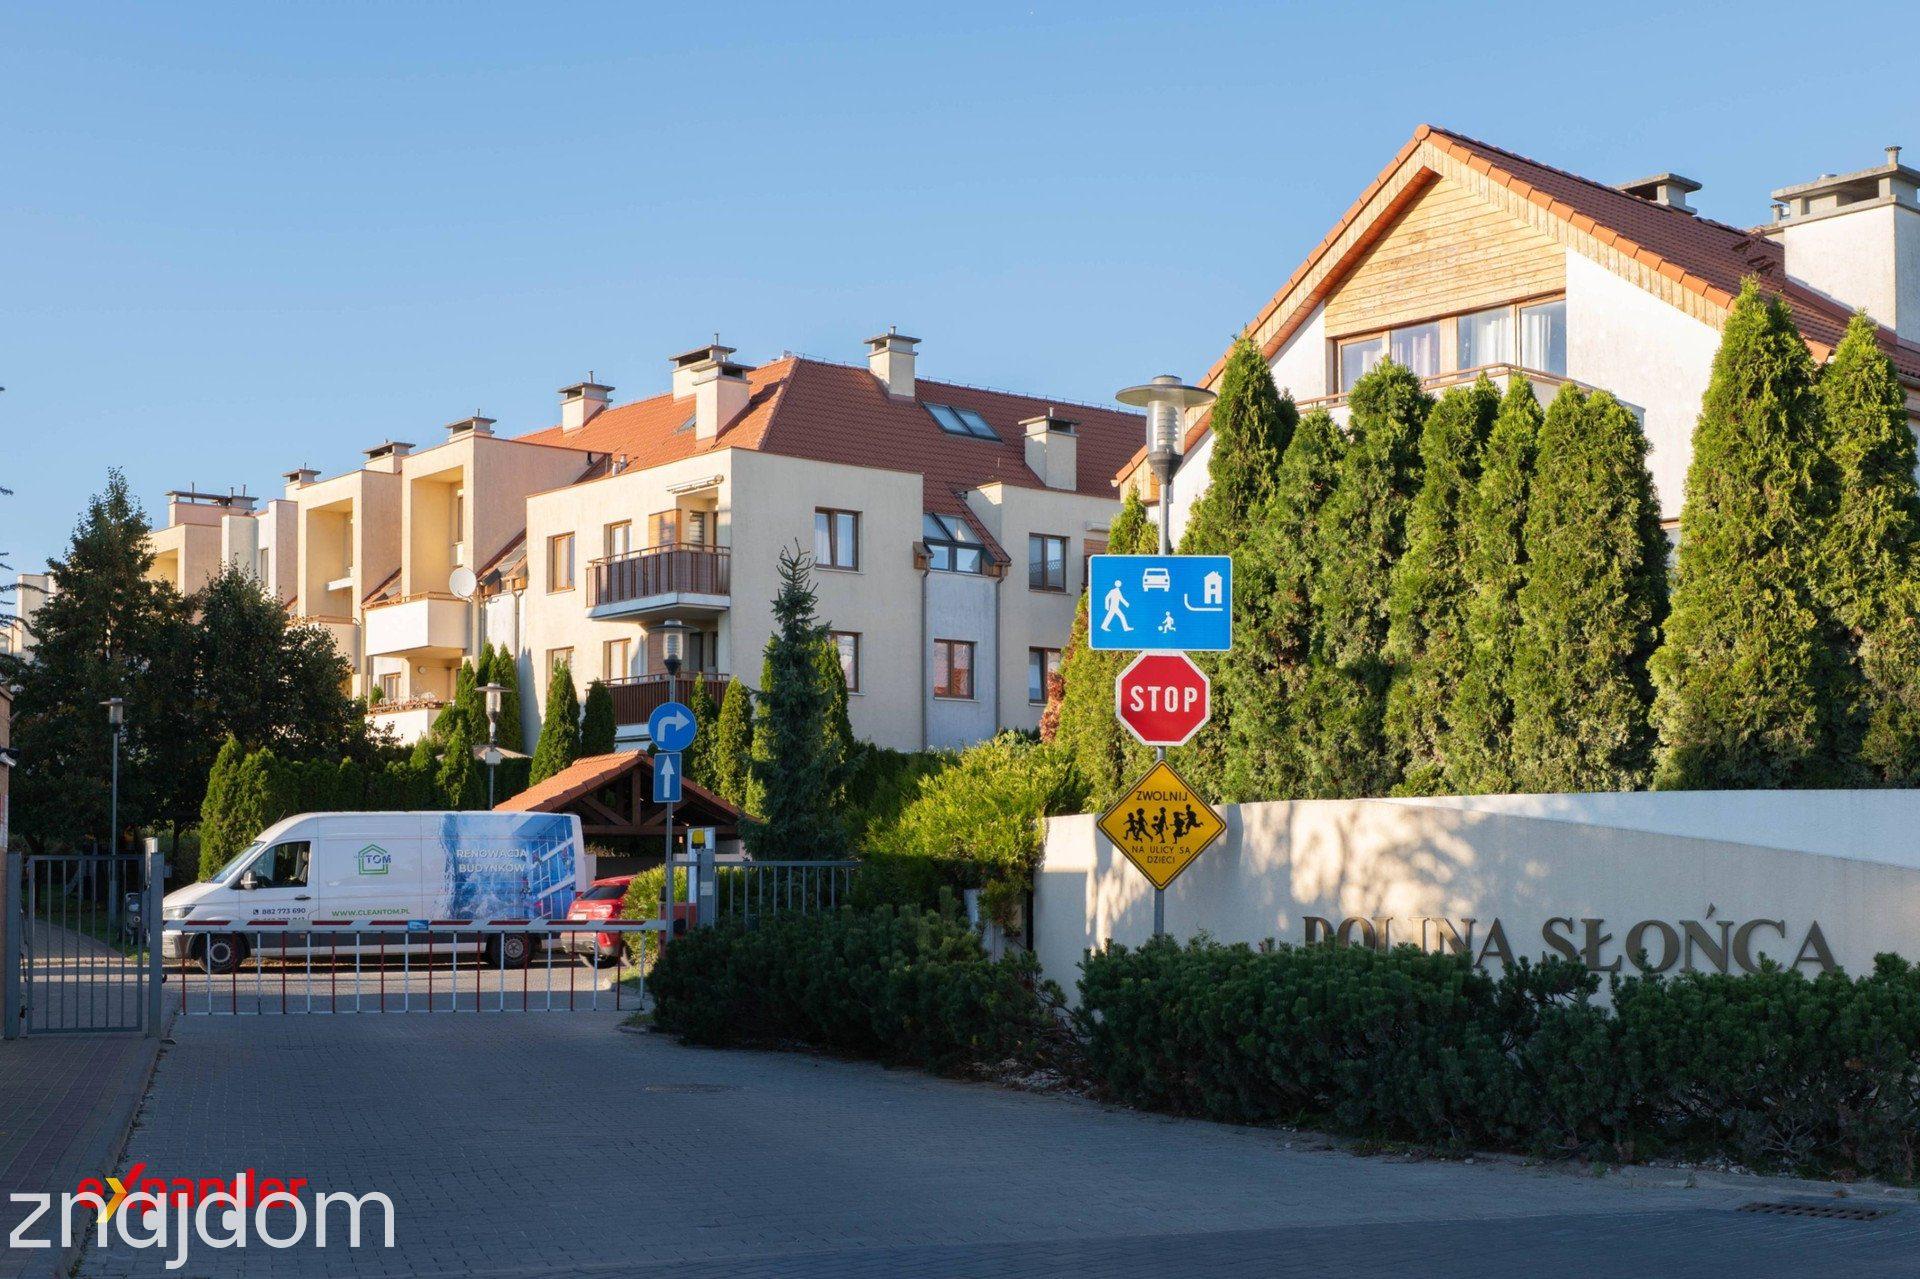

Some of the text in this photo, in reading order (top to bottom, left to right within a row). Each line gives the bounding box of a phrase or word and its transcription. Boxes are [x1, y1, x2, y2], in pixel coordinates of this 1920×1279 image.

[1129, 685, 1198, 713] STOP
[1136, 790, 1188, 801] ZWOLNIJ
[456, 849, 528, 859] RENOWACJA
[1131, 845, 1145, 854] NA
[1149, 845, 1175, 854] ULICY
[365, 854, 392, 864] TOM
[1147, 856, 1175, 864] DZIECI
[459, 862, 526, 873] BUDYNKÓW
[331, 908, 410, 917] WWW.CLEANTOM.PL
[1542, 902, 1837, 975] SŁOŃCA
